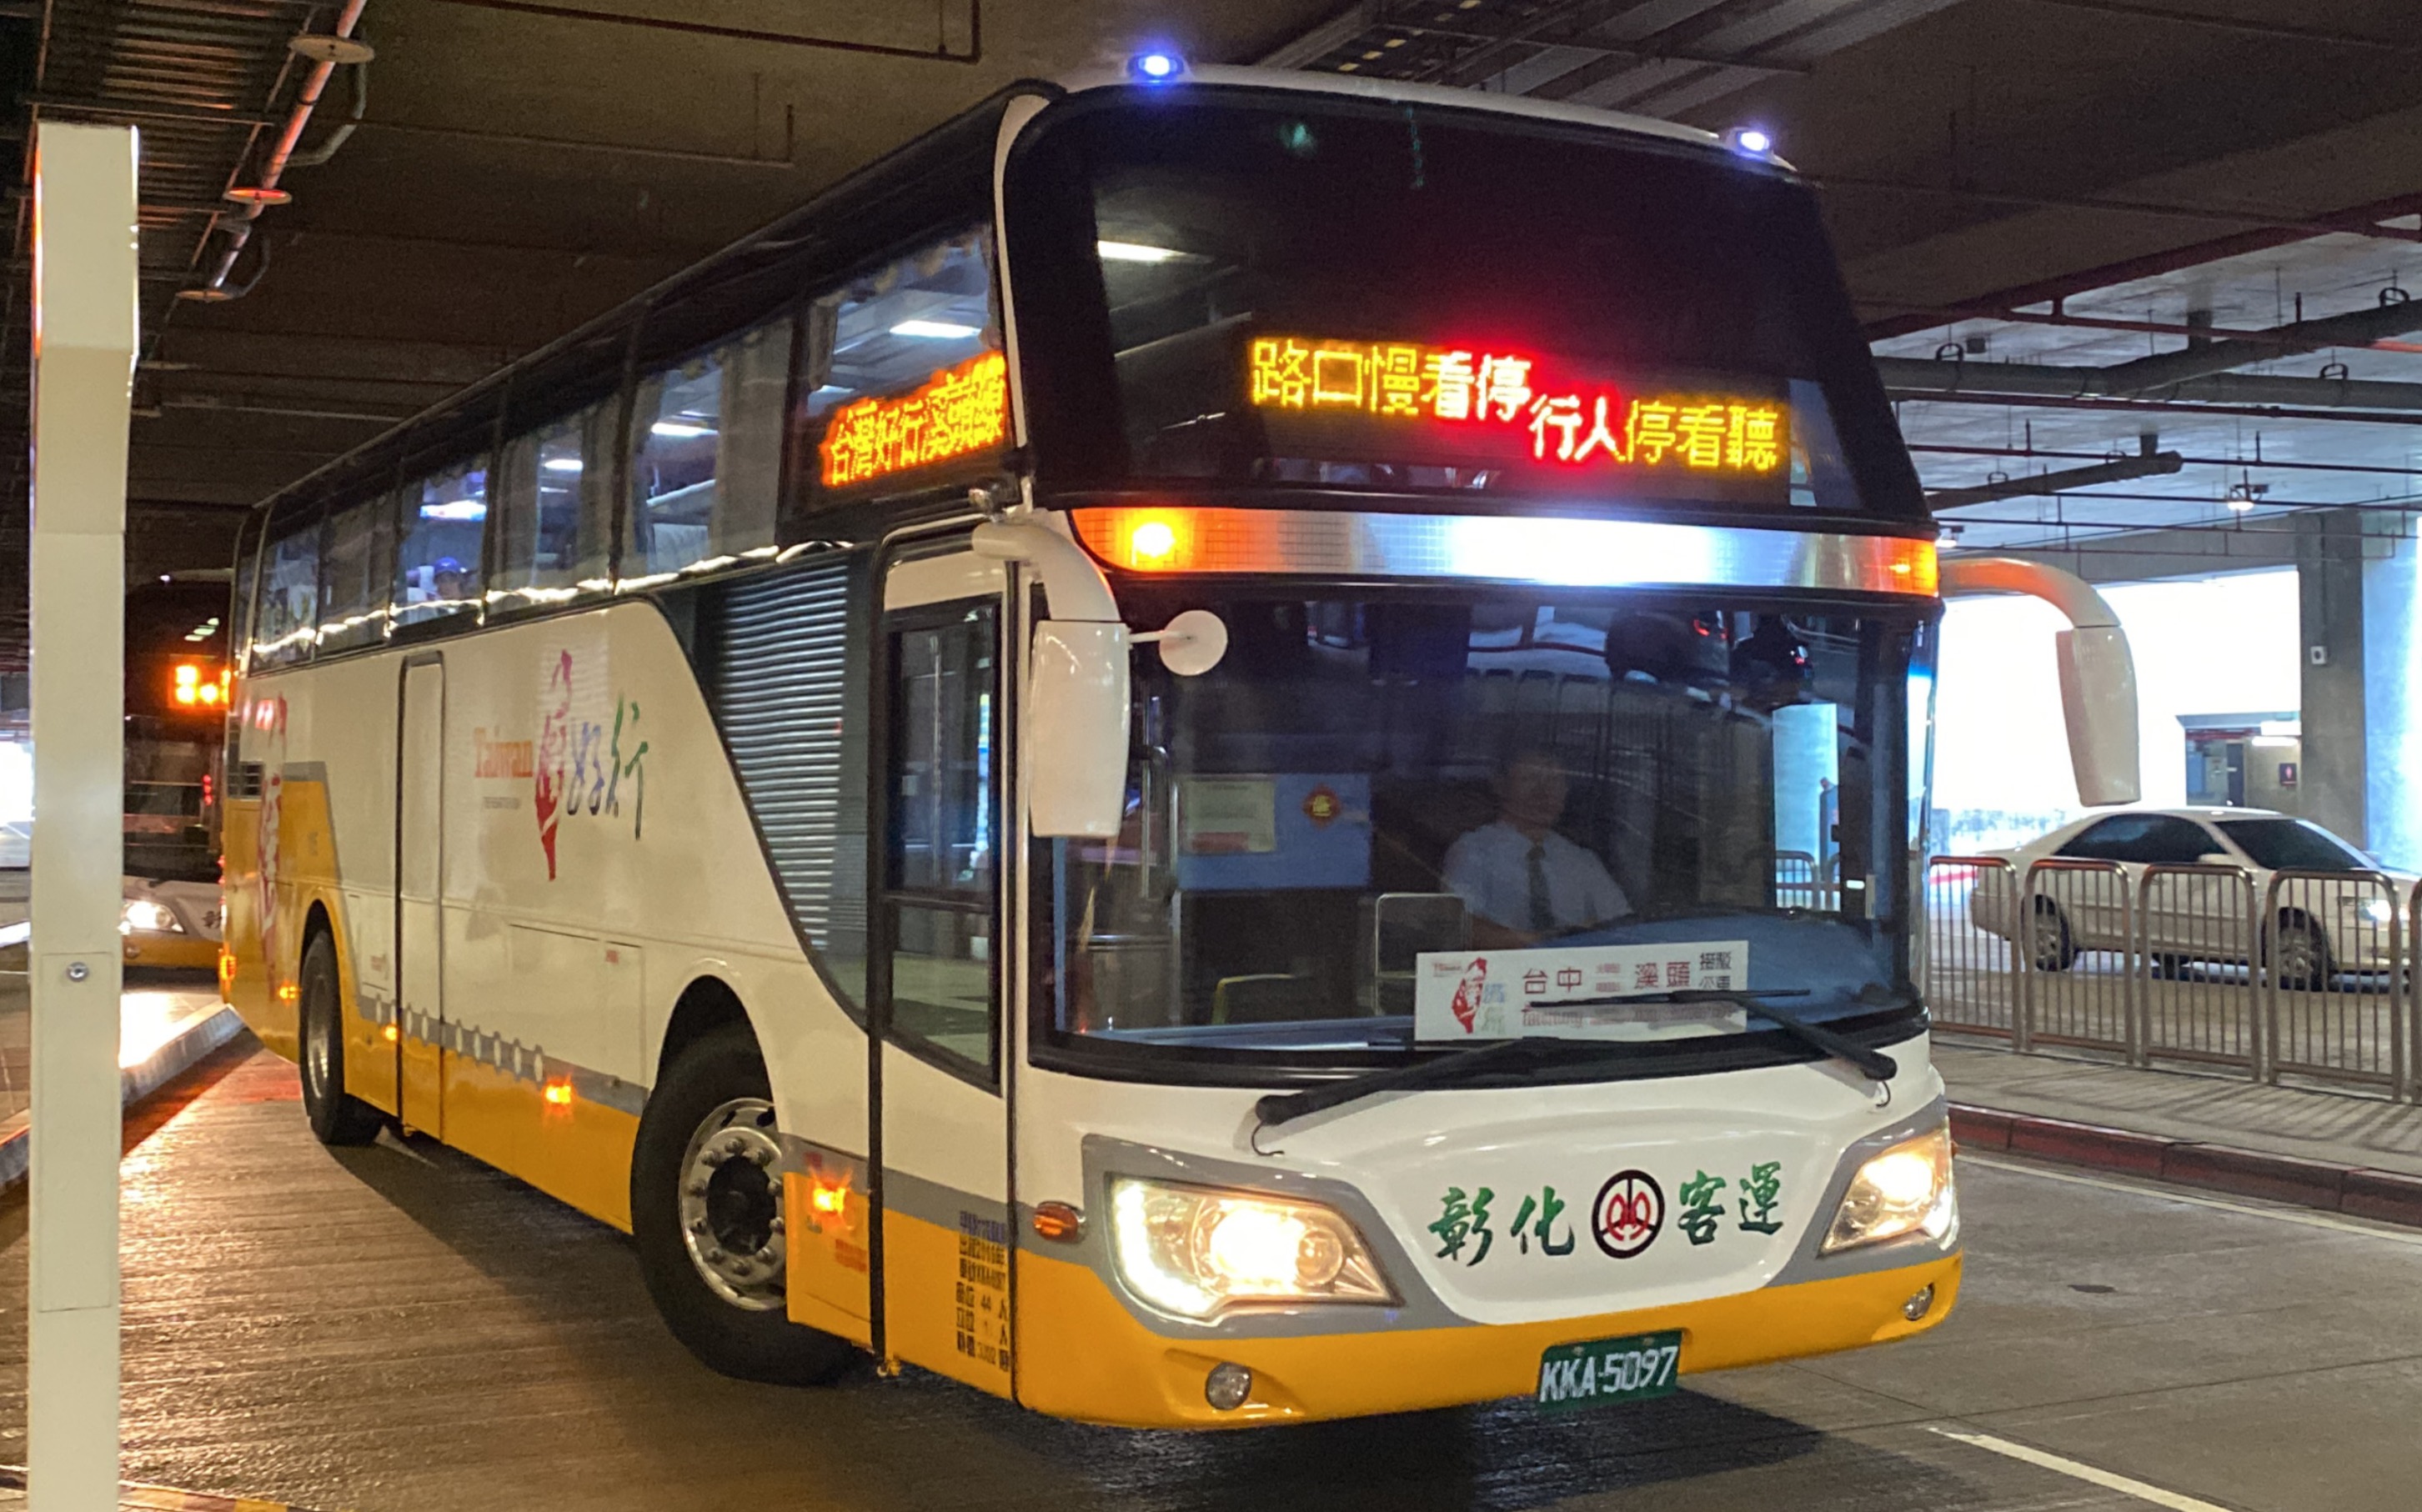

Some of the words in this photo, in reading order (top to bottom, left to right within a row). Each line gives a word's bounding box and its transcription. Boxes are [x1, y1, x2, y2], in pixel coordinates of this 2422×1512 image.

[1522, 967, 1582, 994] 台中
[1427, 1186, 1576, 1267] 彰化
[1677, 1160, 1784, 1246] 客運
[1539, 1346, 1679, 1404] KKA-5097
